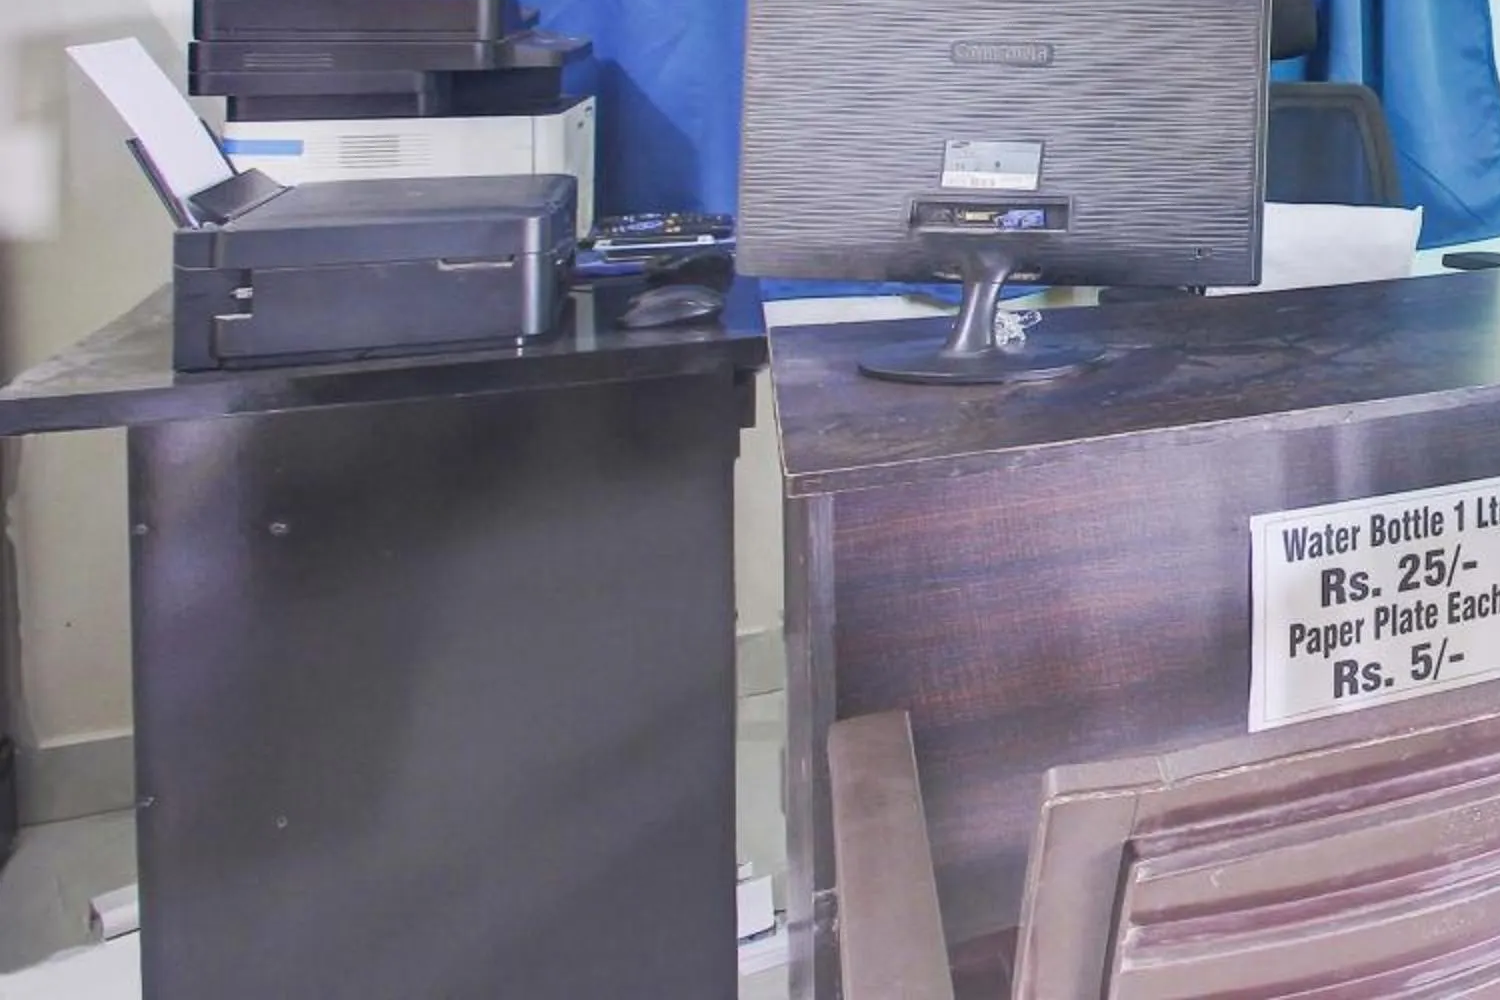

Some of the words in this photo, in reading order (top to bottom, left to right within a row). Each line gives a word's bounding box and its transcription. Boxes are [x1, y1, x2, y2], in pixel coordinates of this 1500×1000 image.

[1282, 523, 1360, 562] Water
[1370, 506, 1444, 546] Bottle
[1453, 500, 1465, 532] 1
[1321, 567, 1382, 608] Rs.
[1397, 543, 1478, 593] 25/-
[1289, 616, 1365, 659] Paper
[1374, 599, 1438, 640] Plate
[1333, 659, 1394, 699] Rs.
[1410, 637, 1464, 681] 5/-
